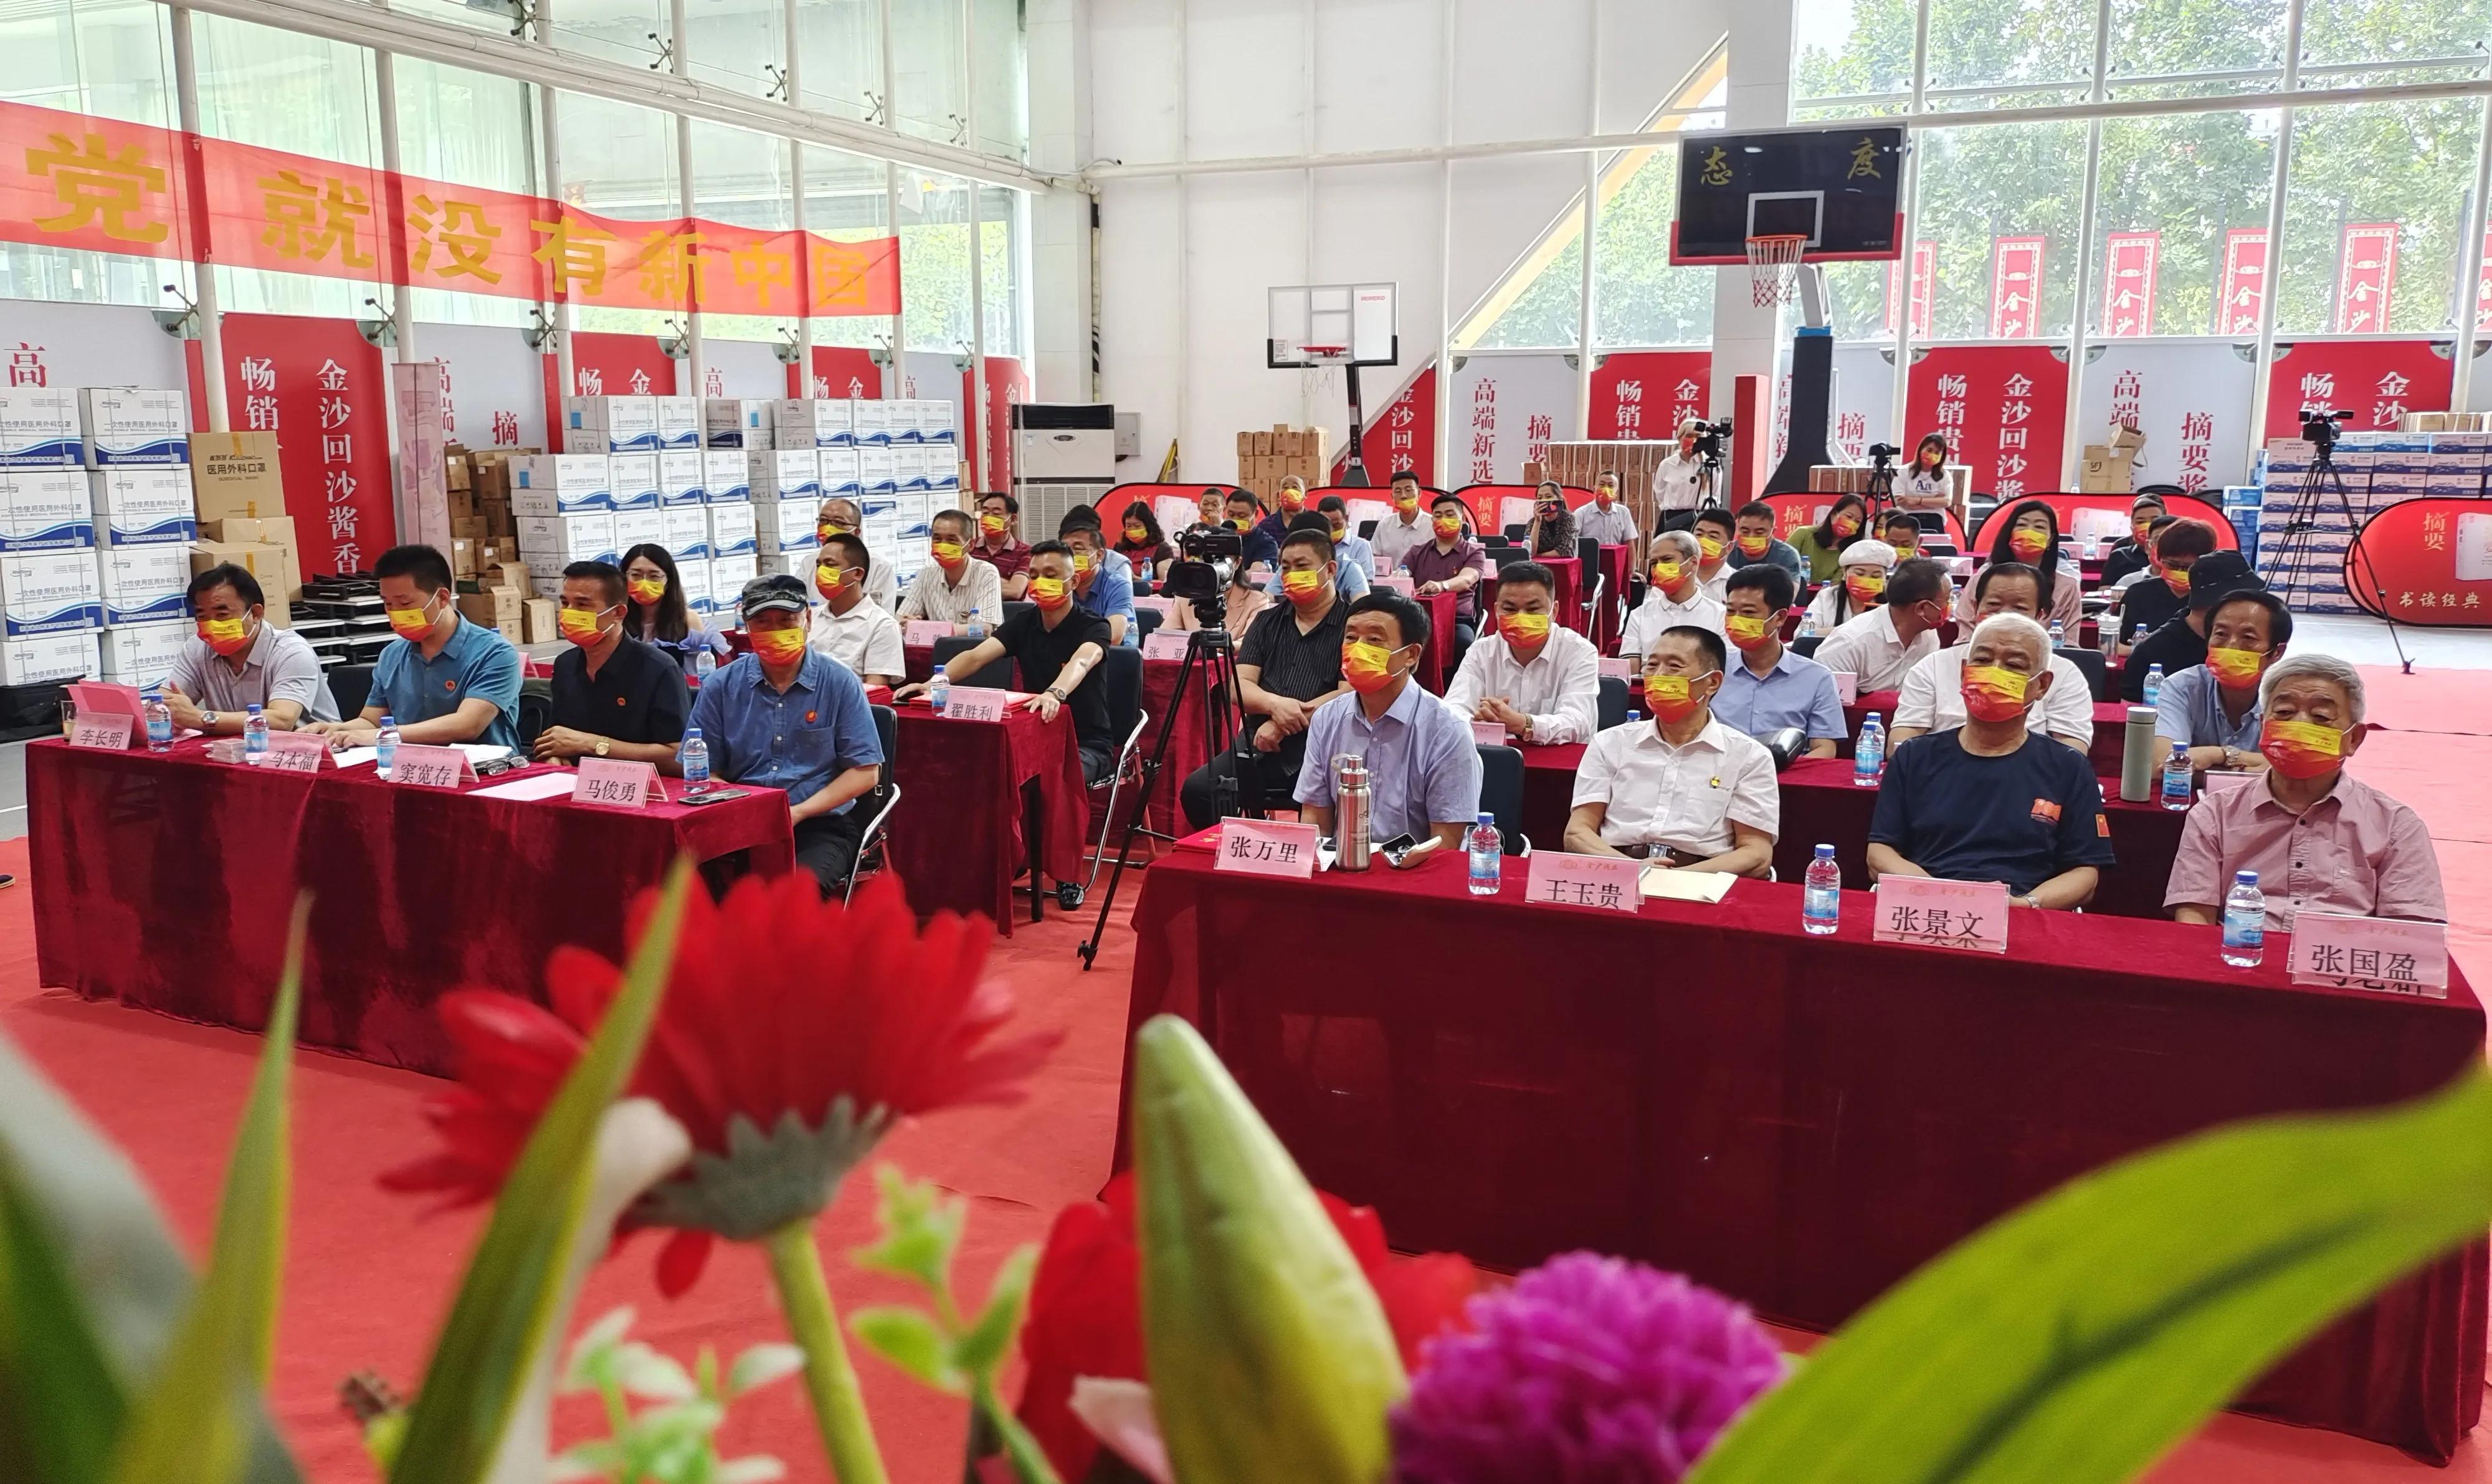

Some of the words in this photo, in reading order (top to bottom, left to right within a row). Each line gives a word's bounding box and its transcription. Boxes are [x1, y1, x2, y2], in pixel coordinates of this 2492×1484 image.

[1700, 146, 1733, 186] 态
[1847, 137, 1881, 180] 度
[25, 133, 169, 244] 党
[257, 170, 870, 308] 就没有新中国
[3, 342, 47, 388] 高
[240, 356, 279, 430] 畅销
[578, 367, 602, 397] 畅
[629, 368, 652, 396] 金
[705, 367, 724, 397] 高
[848, 376, 865, 399] 金
[2372, 371, 2411, 426] 金沙
[492, 410, 519, 446] 摘
[1470, 378, 1497, 484] 高端新选
[1526, 414, 1553, 463] 摘要
[207, 463, 266, 475] 医用外科口罩
[316, 358, 361, 574] 金沙回沙酱香
[2399, 592, 2481, 608] 书读经典
[1149, 647, 1159, 658] 张
[951, 703, 992, 721] 翟胜利
[80, 728, 123, 748] 李长明
[268, 751, 316, 771] 马本福
[399, 762, 452, 785] 窦宽存
[585, 779, 637, 802] 马俊勇
[1230, 835, 1298, 865] 张万里
[1543, 879, 1623, 911] 王玉贵
[1891, 905, 1984, 939] 张景文
[2311, 944, 2418, 982] 张国盈
